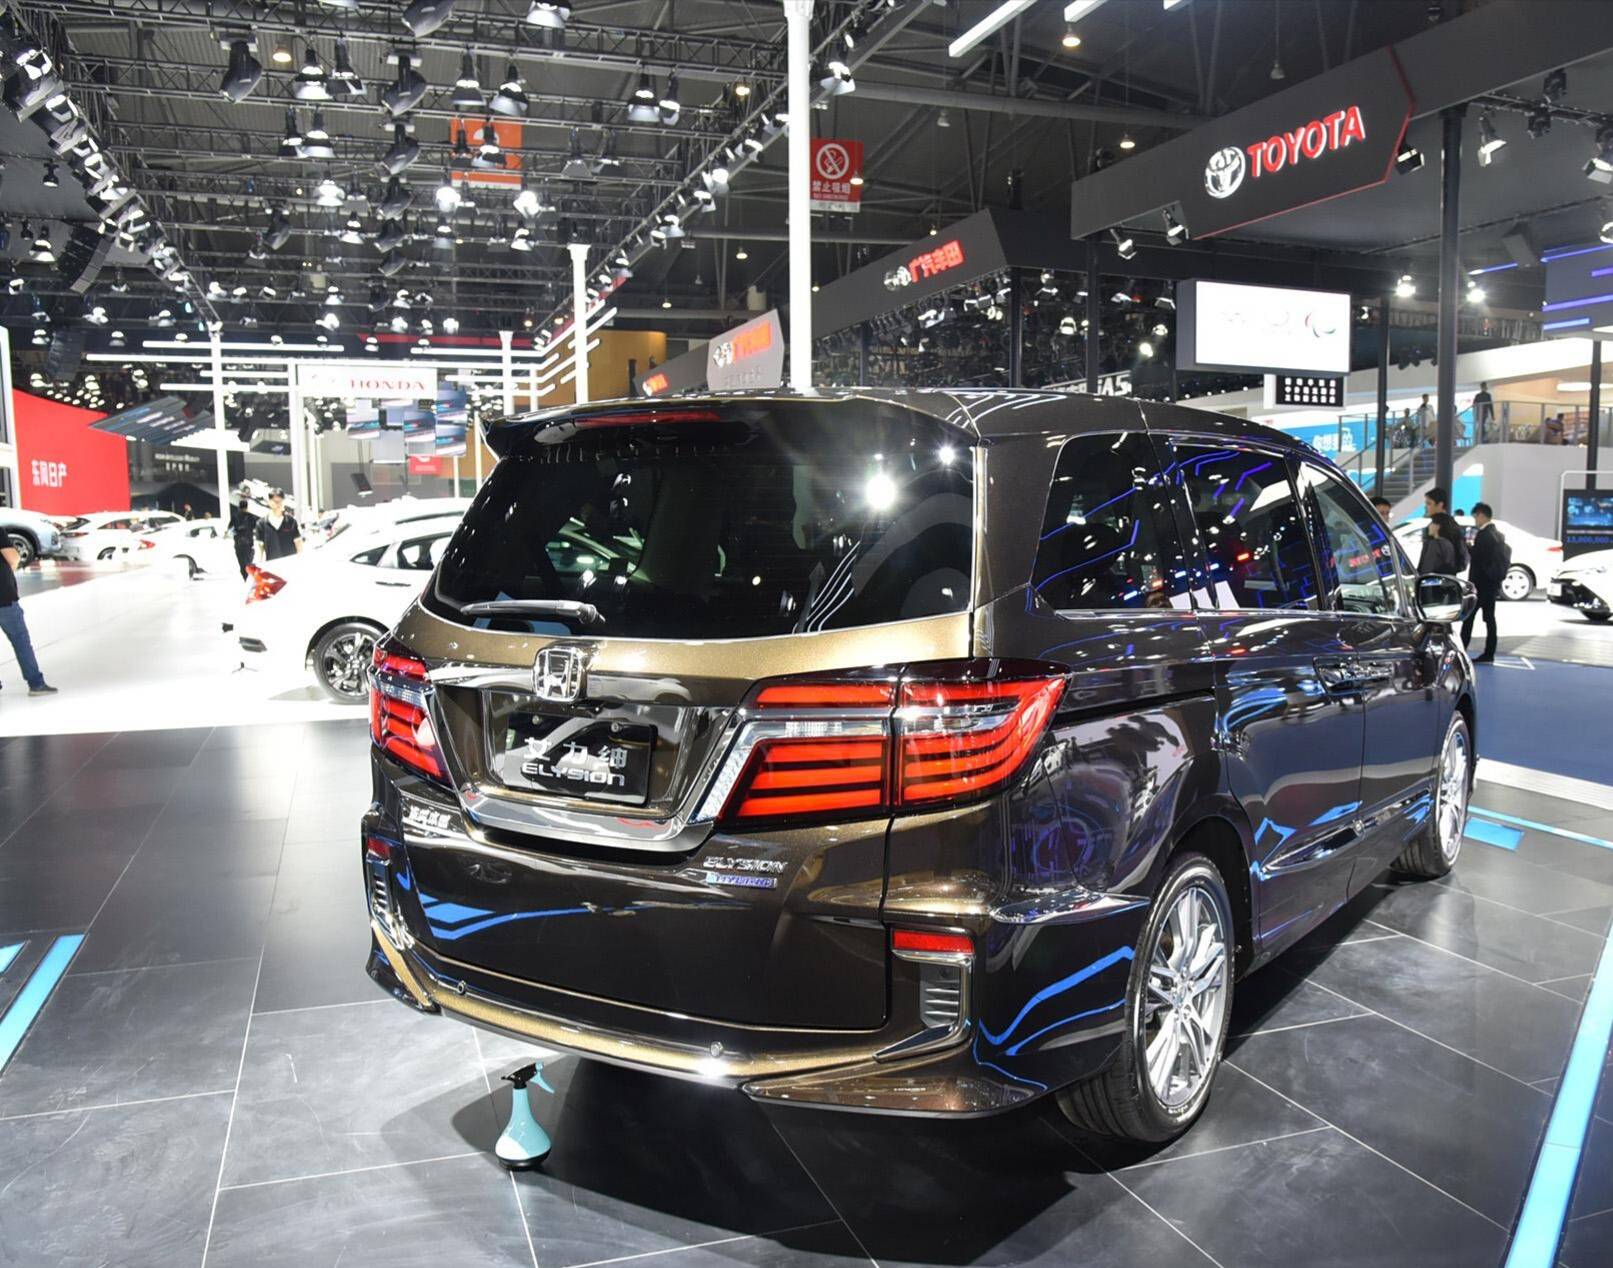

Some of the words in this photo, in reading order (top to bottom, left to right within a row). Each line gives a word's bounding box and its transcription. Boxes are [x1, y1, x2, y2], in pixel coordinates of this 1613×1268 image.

[1247, 105, 1366, 178] TOYOTA
[351, 379, 426, 391] HONDA
[523, 736, 628, 769] 艾力绅
[703, 855, 788, 874] ELYSION
